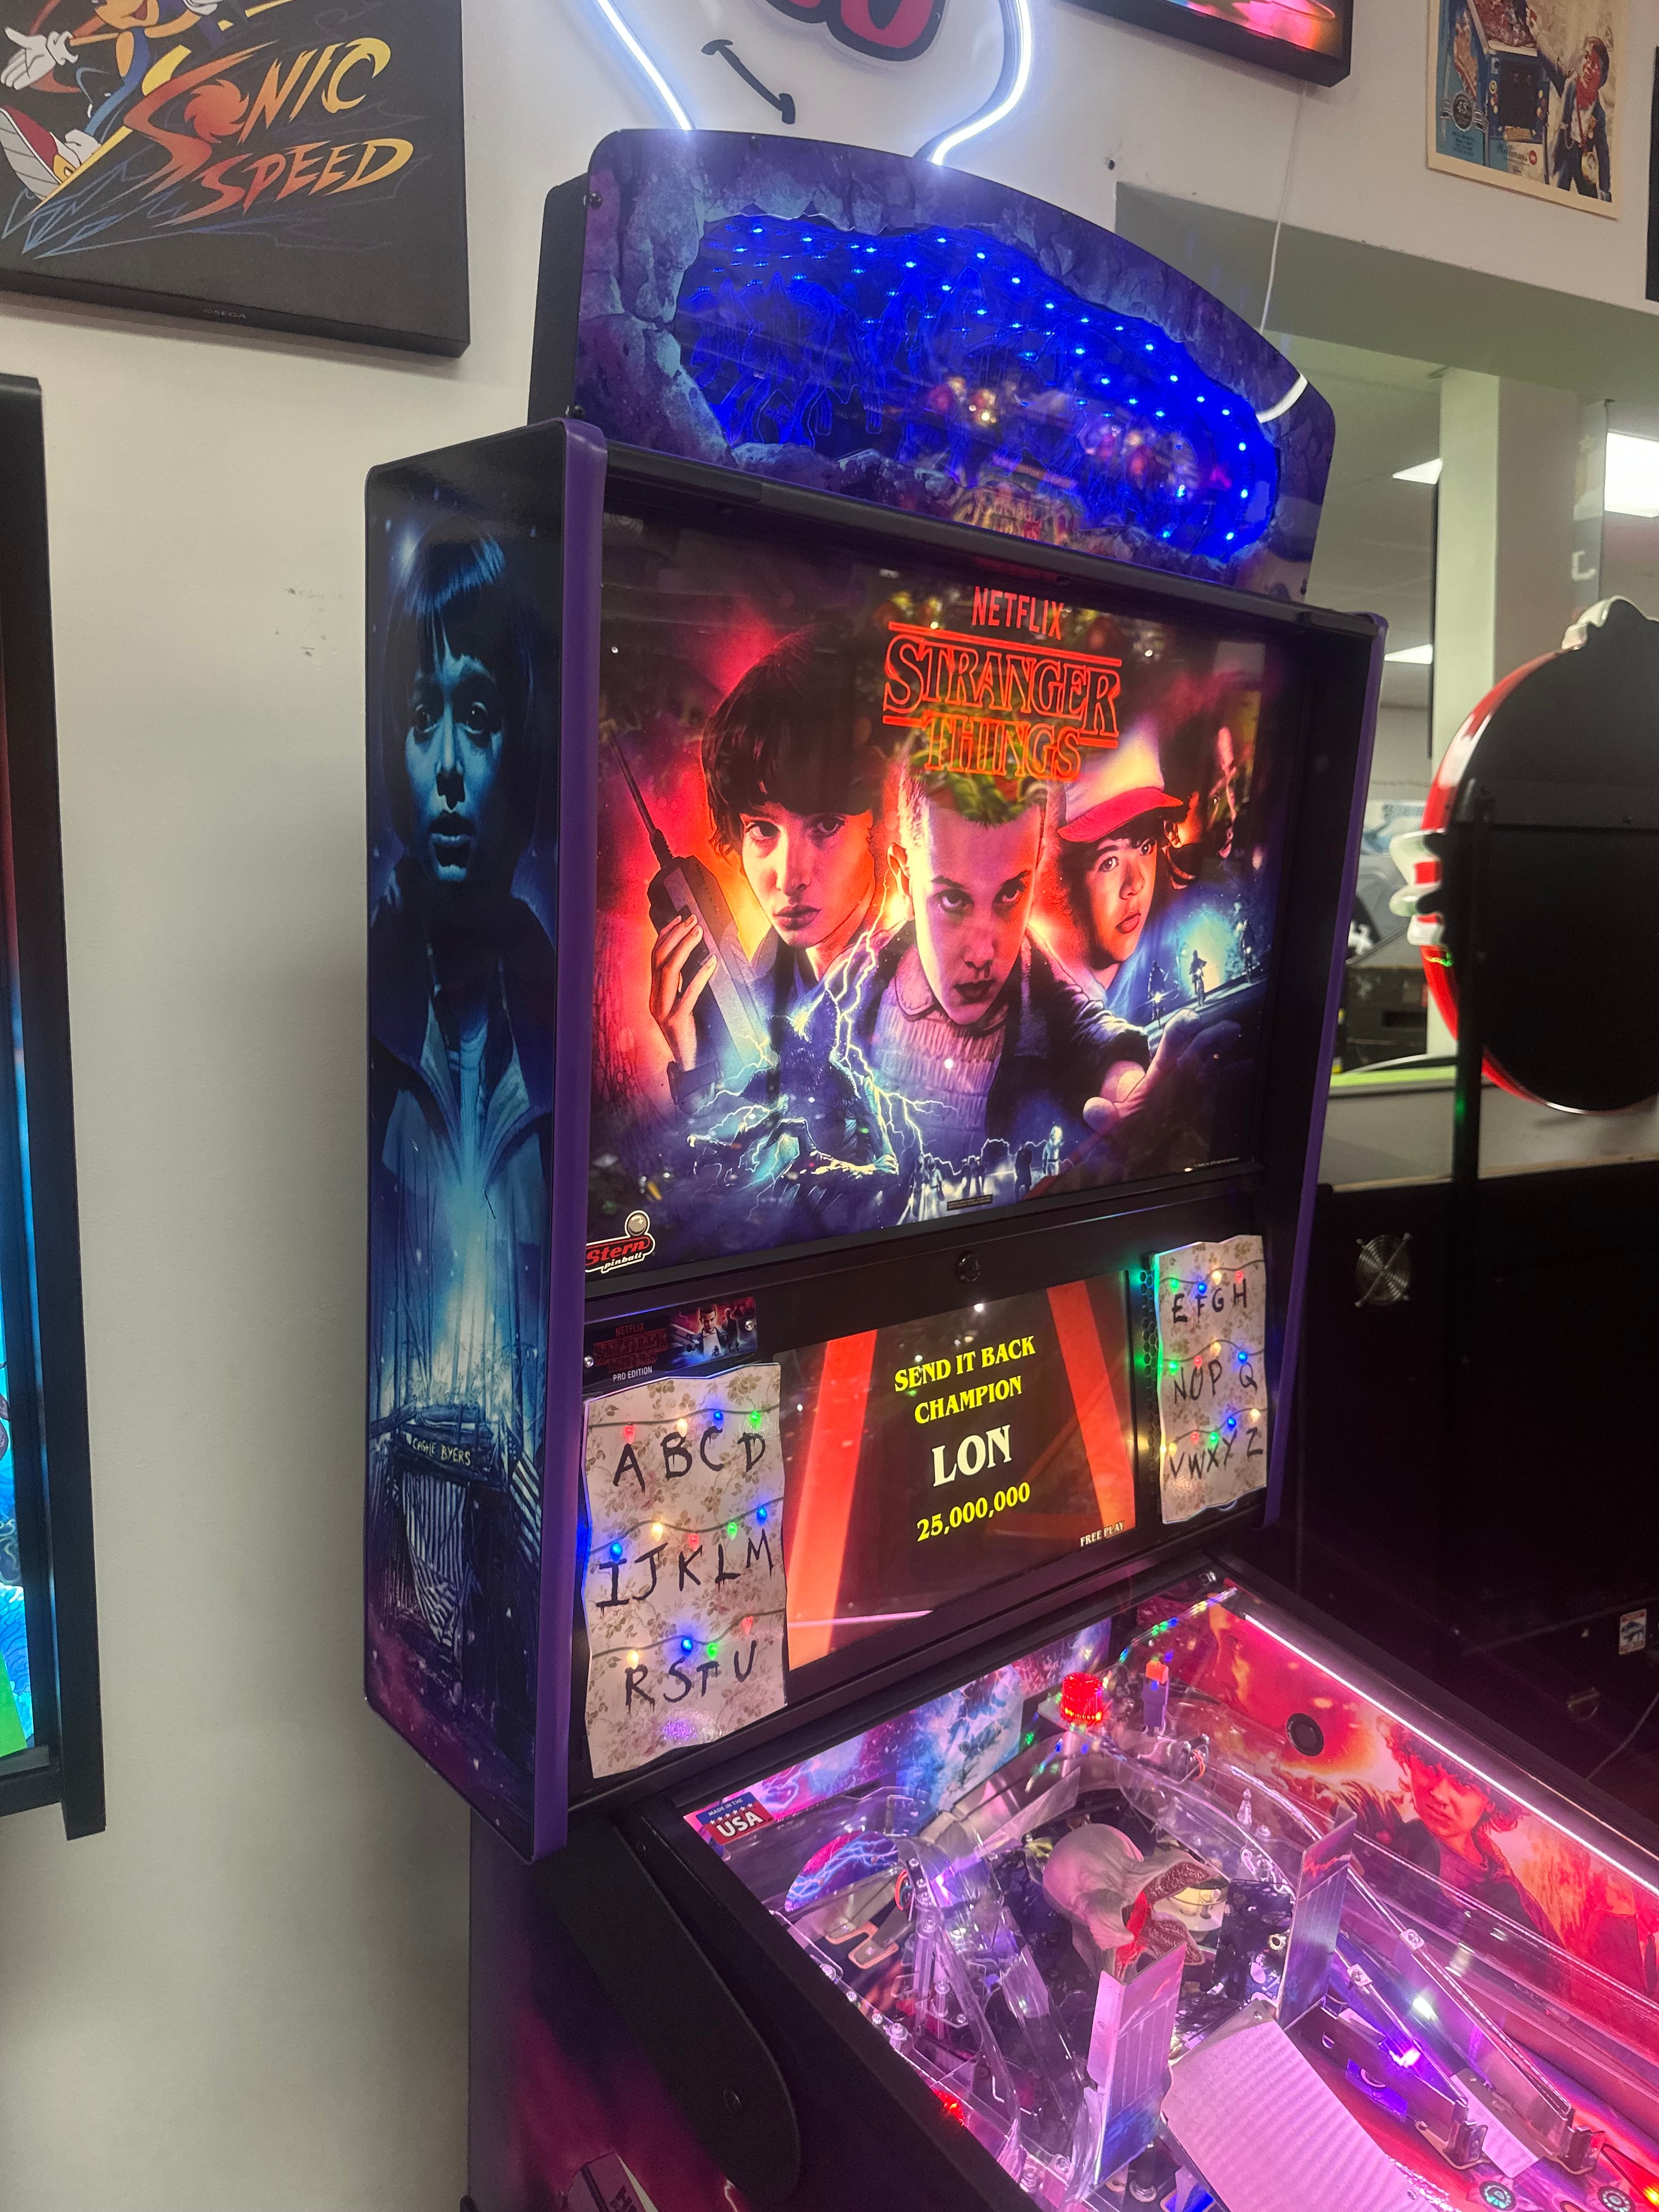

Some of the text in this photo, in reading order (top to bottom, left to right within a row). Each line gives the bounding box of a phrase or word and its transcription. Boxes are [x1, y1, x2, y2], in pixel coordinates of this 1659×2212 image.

[125, 38, 392, 201] SONIC
[153, 138, 414, 228] SPEED
[972, 586, 1064, 640] NETFLIX
[883, 634, 1121, 737] STRANGER
[922, 710, 1081, 782] THINGS
[585, 1241, 645, 1266] Stern
[604, 1252, 642, 1269] pinball
[616, 1322, 645, 1337] NETFLIX
[592, 1331, 668, 1362] STRANGER
[607, 1350, 657, 1373] THINGS
[613, 1365, 652, 1383] PRO EDITION
[894, 1335, 1036, 1392] SEND IT BACK
[914, 1375, 1023, 1424] CHAMPION
[441, 1444, 471, 1466] BYERS
[932, 1425, 1012, 1487] LON
[917, 1482, 1031, 1542] 25,000,000
[1080, 1521, 1124, 1547] FREE PLAY
[708, 1805, 725, 1816] MADE
[716, 1811, 764, 1837] USA
